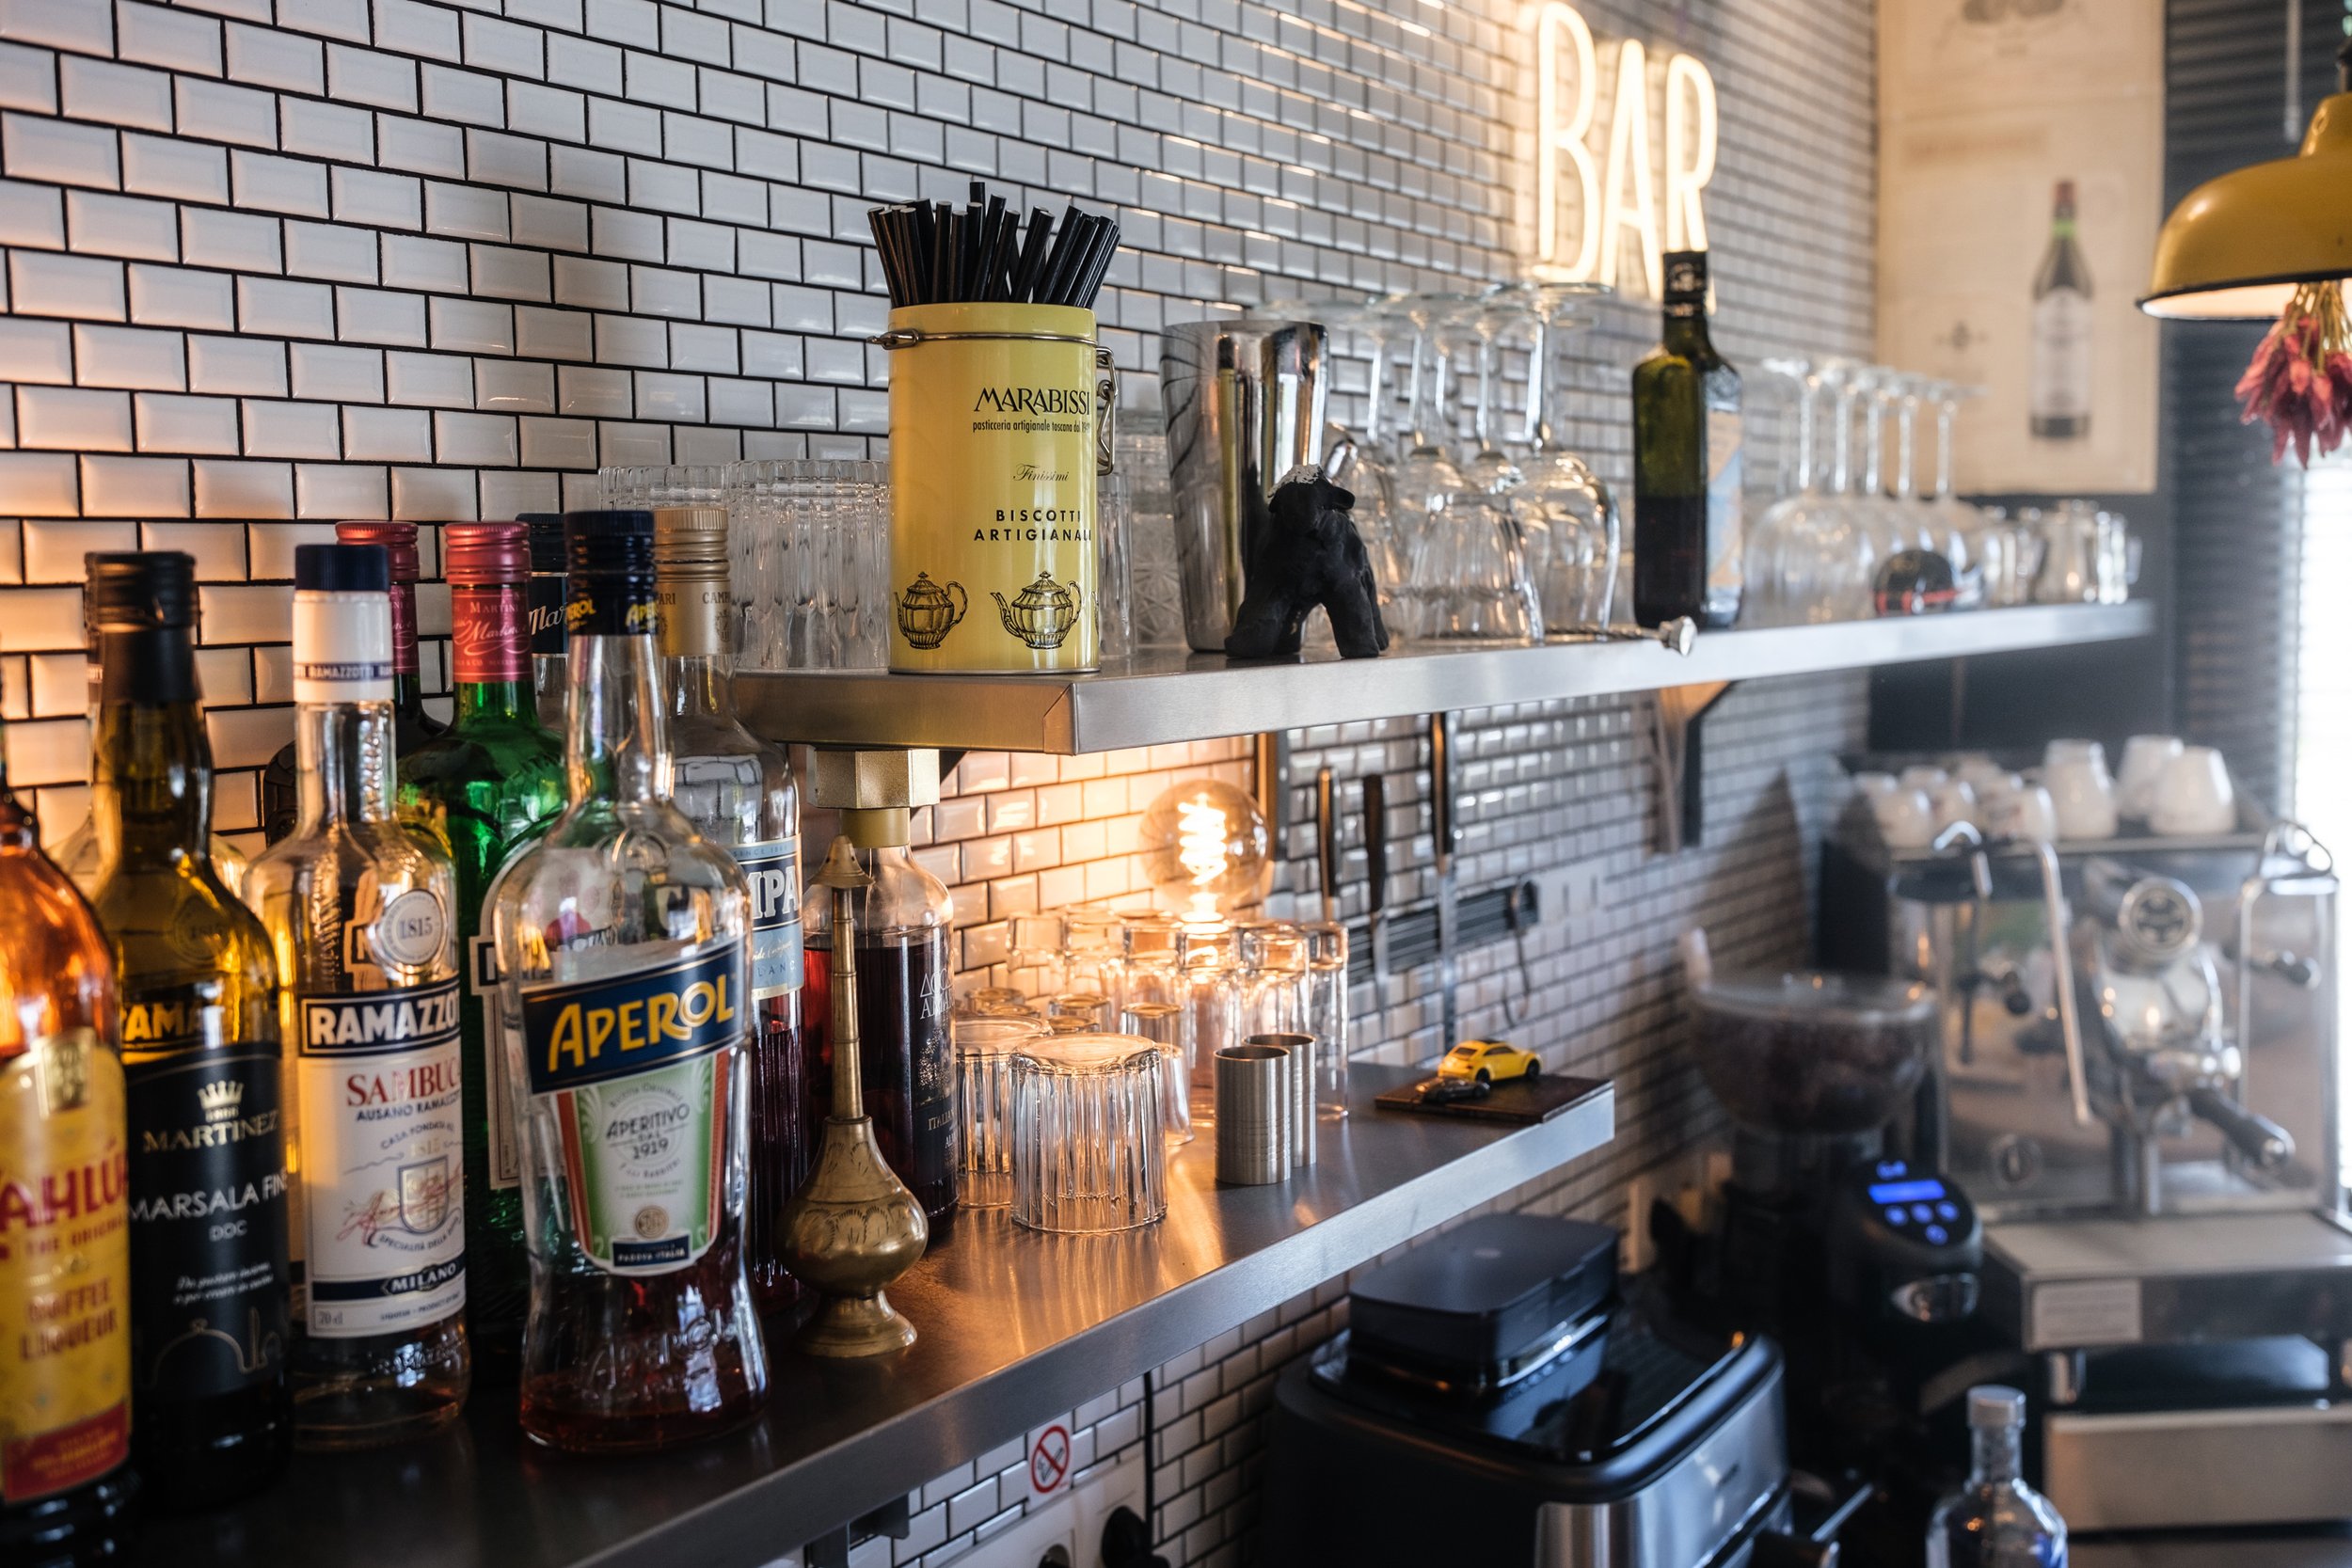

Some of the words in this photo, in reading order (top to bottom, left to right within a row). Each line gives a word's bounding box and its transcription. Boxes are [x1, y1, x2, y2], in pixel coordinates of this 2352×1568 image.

[1532, 3, 1718, 314] BAR
[974, 387, 1090, 416] MARABISSI
[973, 420, 1011, 433] pasticceria
[1013, 420, 1051, 434] artigianale
[1052, 421, 1073, 433] toscana
[1013, 464, 1069, 481] Finissimi
[996, 510, 1081, 522] BISCOTTI
[398, 918, 433, 939] 1815
[548, 974, 734, 1072] APEROL
[346, 1055, 460, 1107] SAMBUC
[356, 1104, 414, 1122] AUSANO
[606, 1102, 691, 1140] APERITIVO
[143, 1109, 278, 1154] MARTINEZ
[632, 1137, 669, 1161] 1919
[208, 1219, 248, 1243] DOC
[390, 1263, 457, 1291] MILANO
